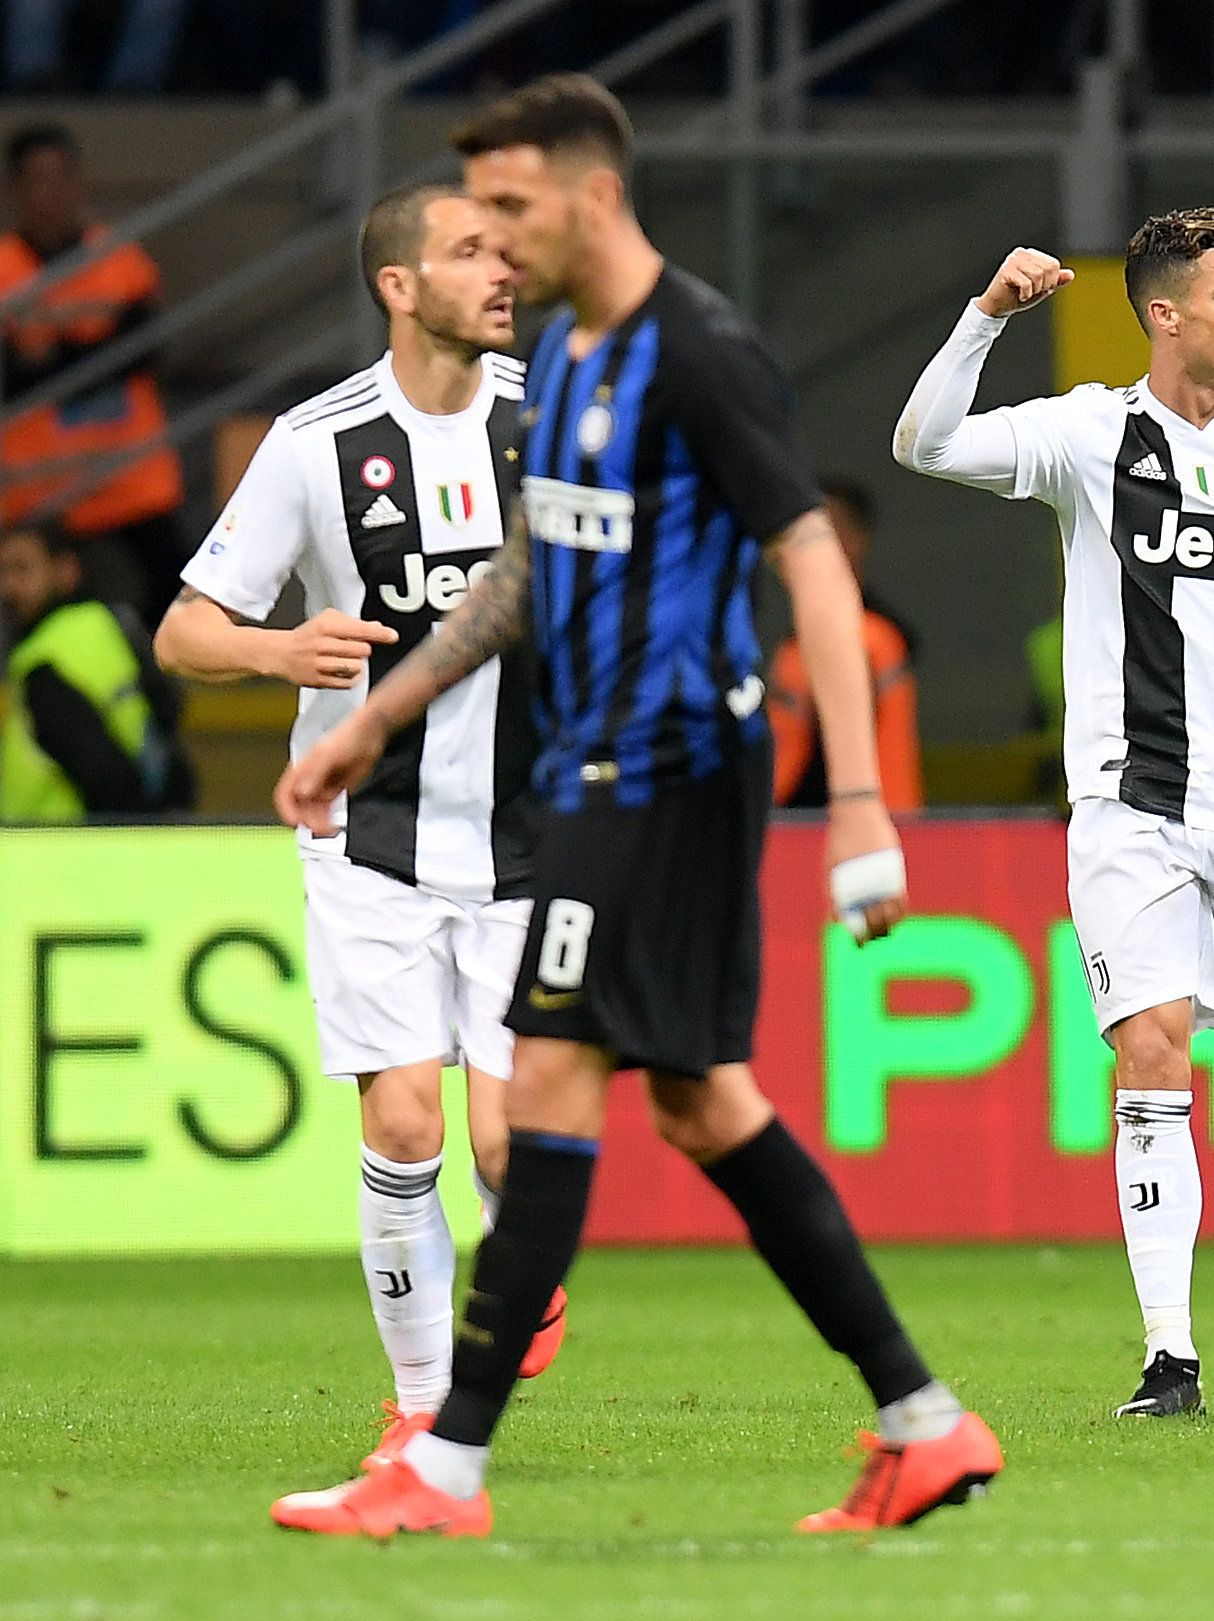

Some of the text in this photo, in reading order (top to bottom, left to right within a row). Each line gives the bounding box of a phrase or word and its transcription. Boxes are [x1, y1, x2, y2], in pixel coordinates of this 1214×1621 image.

[1129, 467, 1167, 481] adidas
[379, 553, 495, 614] Je
[537, 898, 595, 990] 8
[32, 928, 305, 1163] ES
